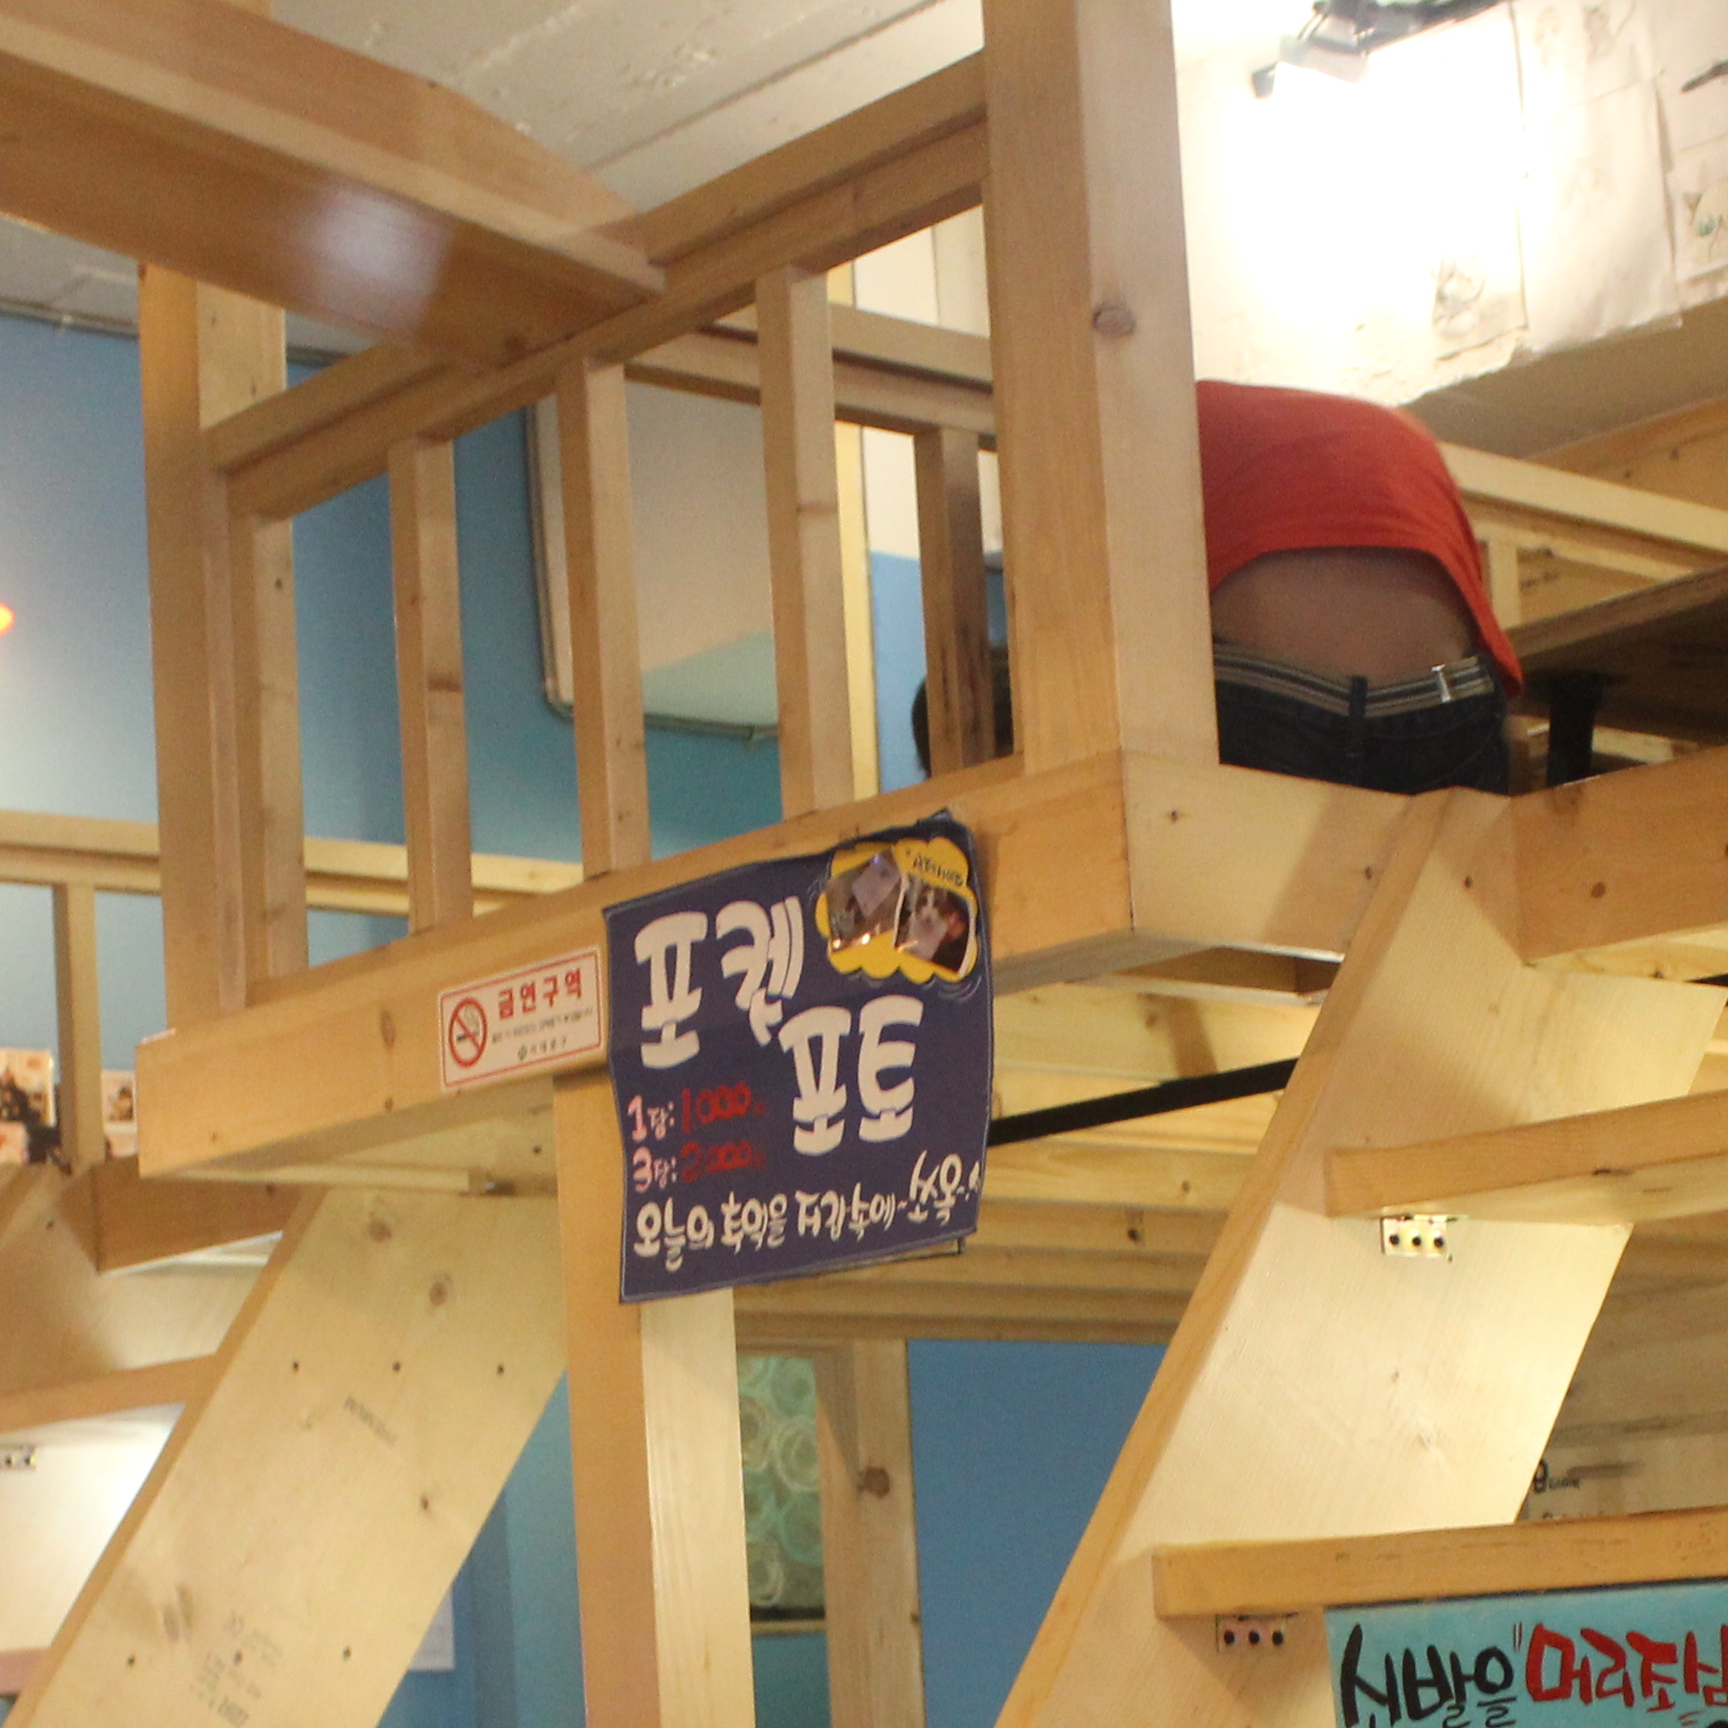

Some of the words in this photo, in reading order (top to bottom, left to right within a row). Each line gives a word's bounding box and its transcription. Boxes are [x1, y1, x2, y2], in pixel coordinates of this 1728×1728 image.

[498, 967, 582, 1020] 금연구역
[633, 896, 805, 1069] 포켓
[778, 994, 924, 1156] 포토
[633, 1197, 715, 1272] 오늘의
[721, 1191, 788, 1255] 추억을
